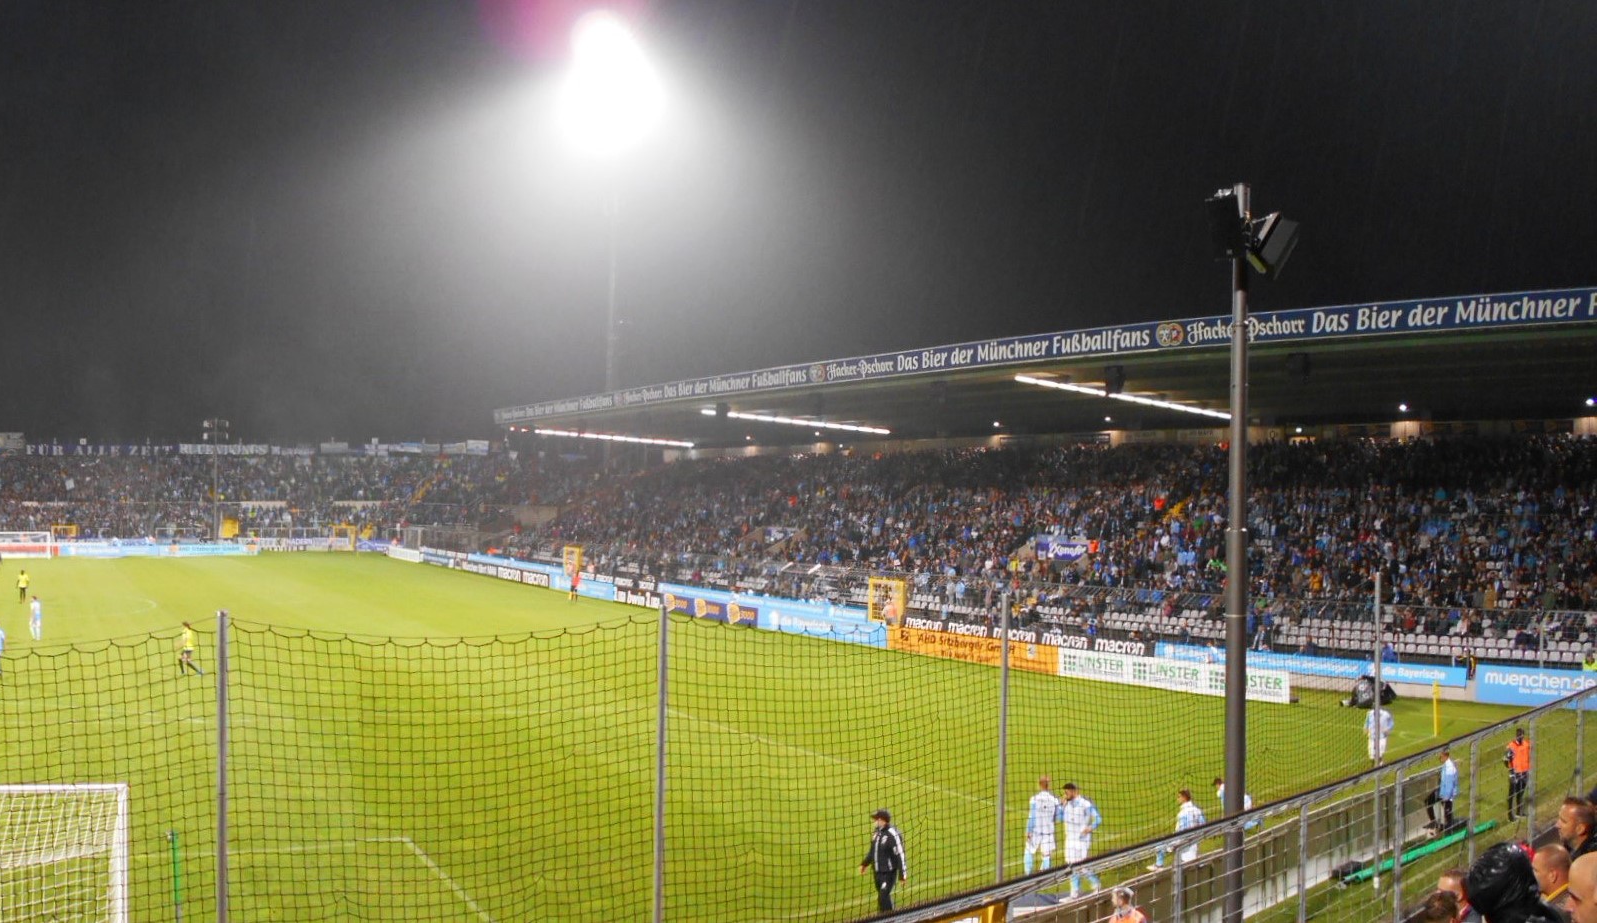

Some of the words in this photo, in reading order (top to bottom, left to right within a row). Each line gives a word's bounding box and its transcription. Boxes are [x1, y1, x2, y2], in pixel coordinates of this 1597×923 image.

[1187, 314, 1305, 345] HackePschorr
[1312, 311, 1349, 334] Das
[1356, 306, 1402, 331] Bier
[1408, 303, 1449, 327] der
[1454, 295, 1581, 325] Münchner
[826, 359, 894, 381] Hacker-Pschorr
[897, 355, 918, 371] Das
[922, 351, 947, 369] Bier
[950, 348, 974, 364] der
[977, 339, 1049, 362] Münchner
[1053, 328, 1150, 356] Fußballfans
[664, 385, 677, 398] Das
[678, 382, 693, 396] Bier
[695, 380, 708, 393] der
[709, 377, 750, 393] Münchner
[752, 369, 807, 390] Fußballfans
[25, 442, 64, 456] FÜR
[73, 444, 121, 456] ALLE
[128, 443, 174, 456] ZEIT
[498, 566, 522, 582] macron
[522, 571, 549, 588] macron
[906, 617, 943, 631] macron
[948, 622, 988, 637] macron
[993, 627, 1036, 643] mcron
[1042, 632, 1088, 650] macron
[1095, 637, 1145, 656] macron
[918, 633, 936, 644] AHD
[940, 635, 983, 651] Sitzberger
[988, 641, 1016, 655] GmH
[1079, 655, 1124, 671] LINSTER
[1149, 663, 1199, 681] LINSTER
[1398, 668, 1447, 680] Bayerische
[1484, 670, 1596, 690] muenchen.de
